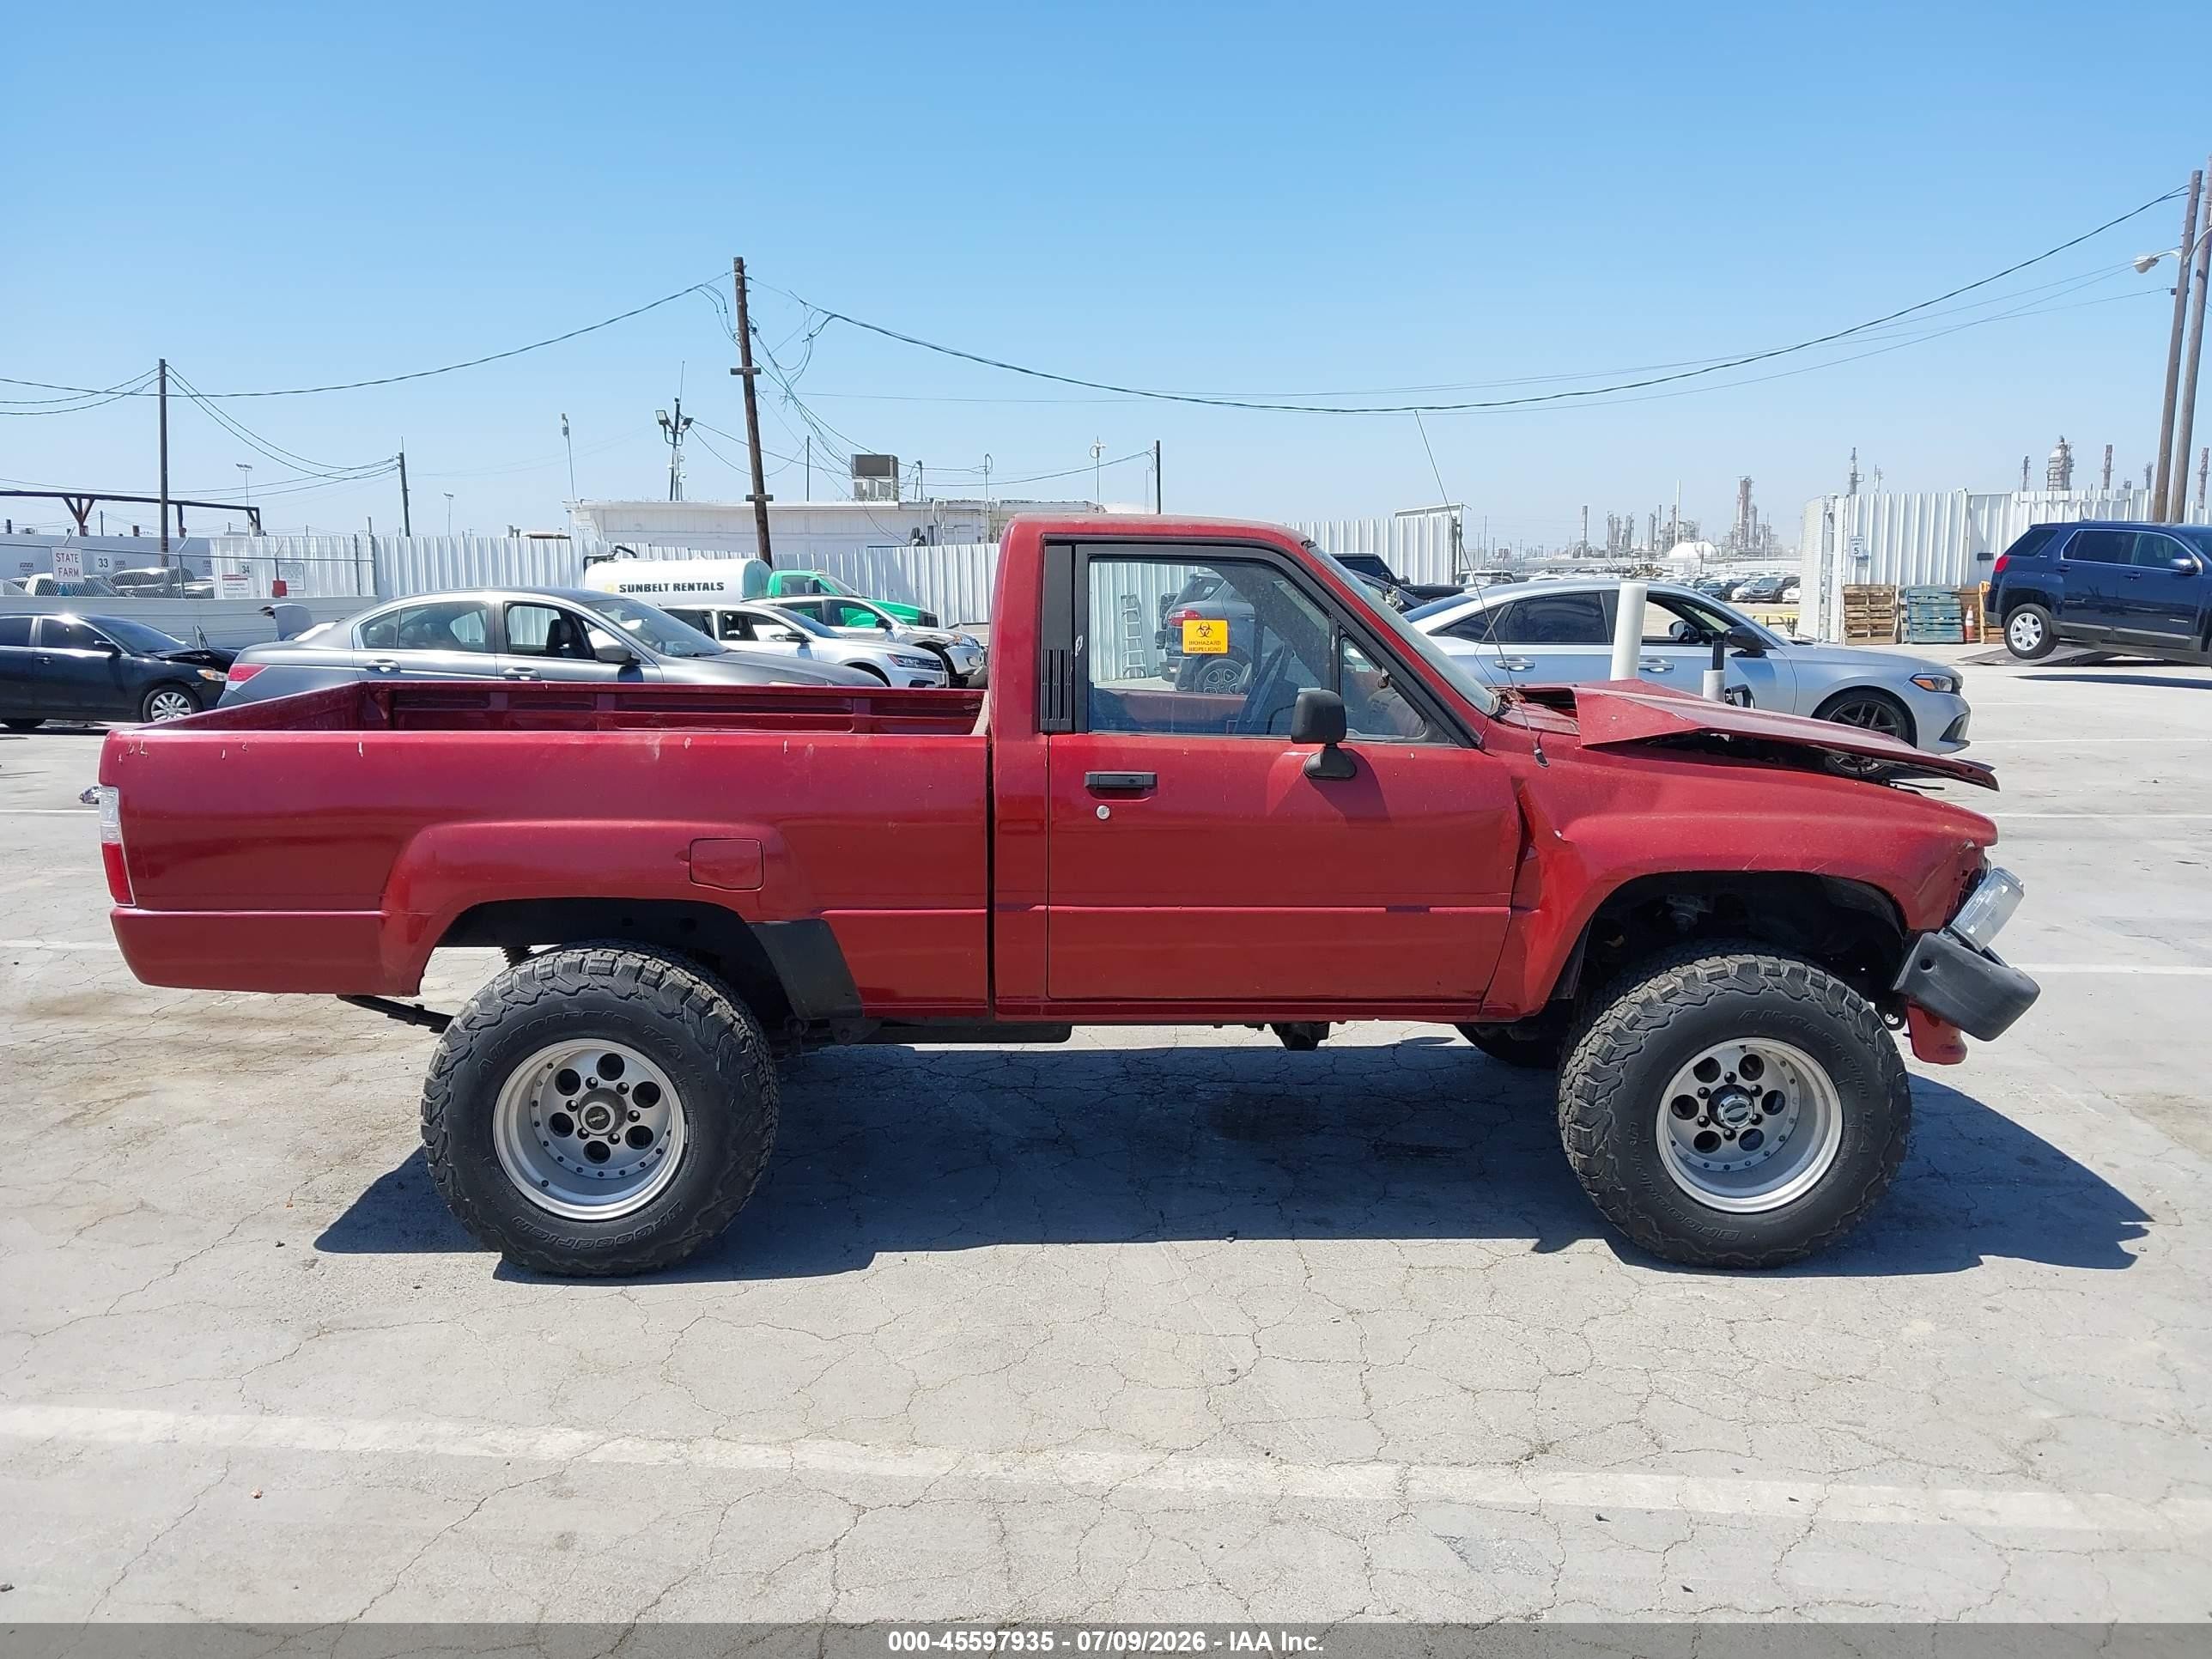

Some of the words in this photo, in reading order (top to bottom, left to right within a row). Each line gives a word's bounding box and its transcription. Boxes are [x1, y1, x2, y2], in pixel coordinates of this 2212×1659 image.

[56, 552, 79, 563] STATE
[98, 557, 109, 568] 33
[58, 567, 80, 578] FARM
[241, 564, 250, 574] 34
[619, 583, 670, 592] SUNBELT
[673, 582, 724, 591] RENTALS
